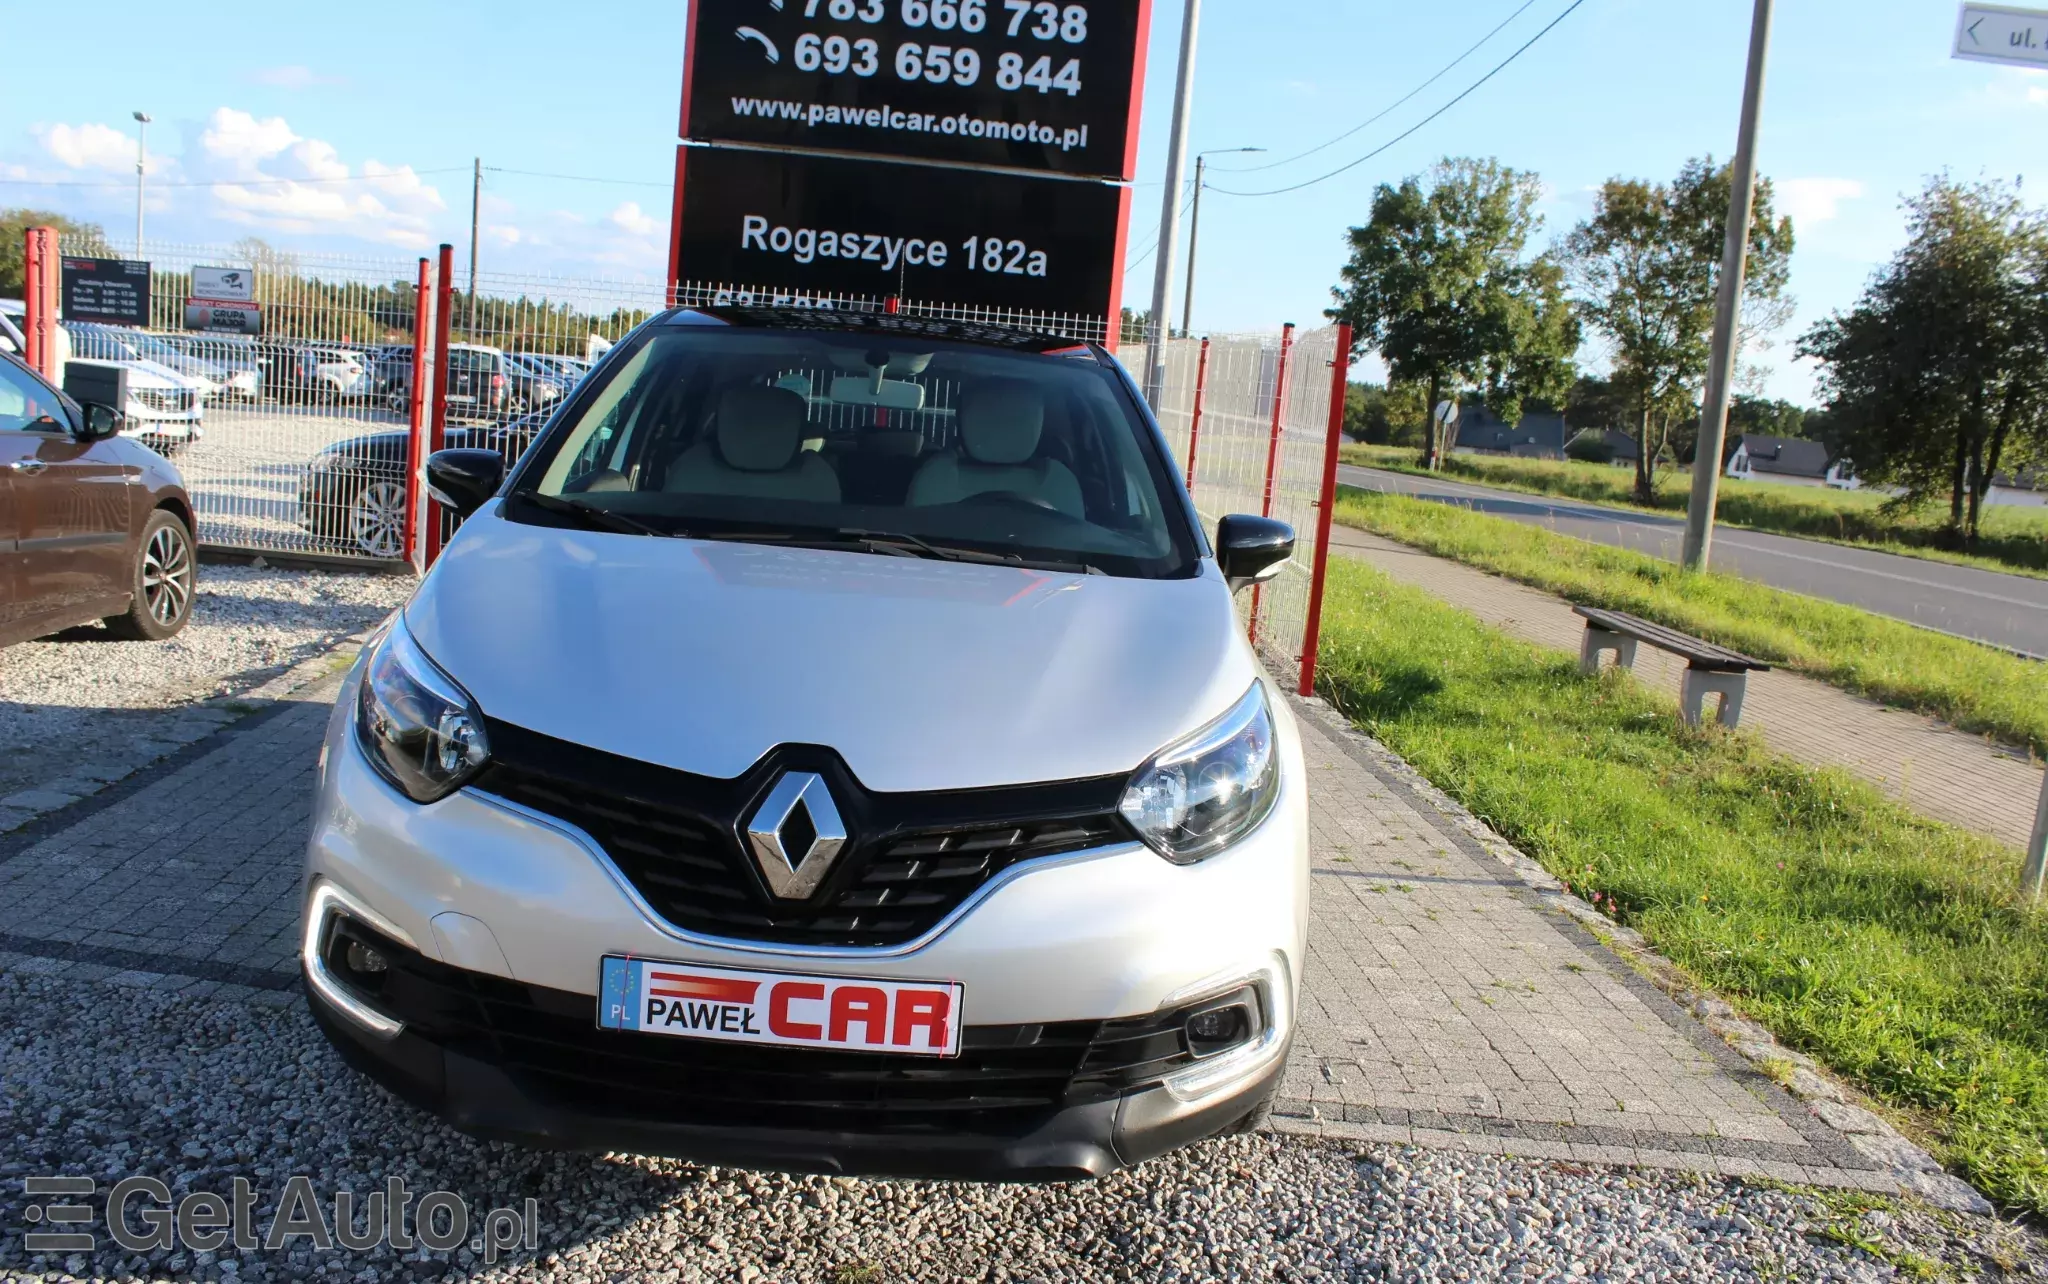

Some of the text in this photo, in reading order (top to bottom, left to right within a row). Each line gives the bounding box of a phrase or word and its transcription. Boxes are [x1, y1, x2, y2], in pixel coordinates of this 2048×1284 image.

[901, 0, 986, 33] 666
[1004, 0, 1087, 43] 738
[2009, 28, 2037, 48] ul.
[794, 33, 1082, 96] 693 659 844
[731, 97, 1088, 151] www.pawelcar.otomoto.pl
[741, 215, 1048, 276] Rogaszyce 182a
[213, 309, 246, 319] GRUPA
[611, 1004, 631, 1021] PL
[646, 981, 951, 1048] PAWEŁ CAR
